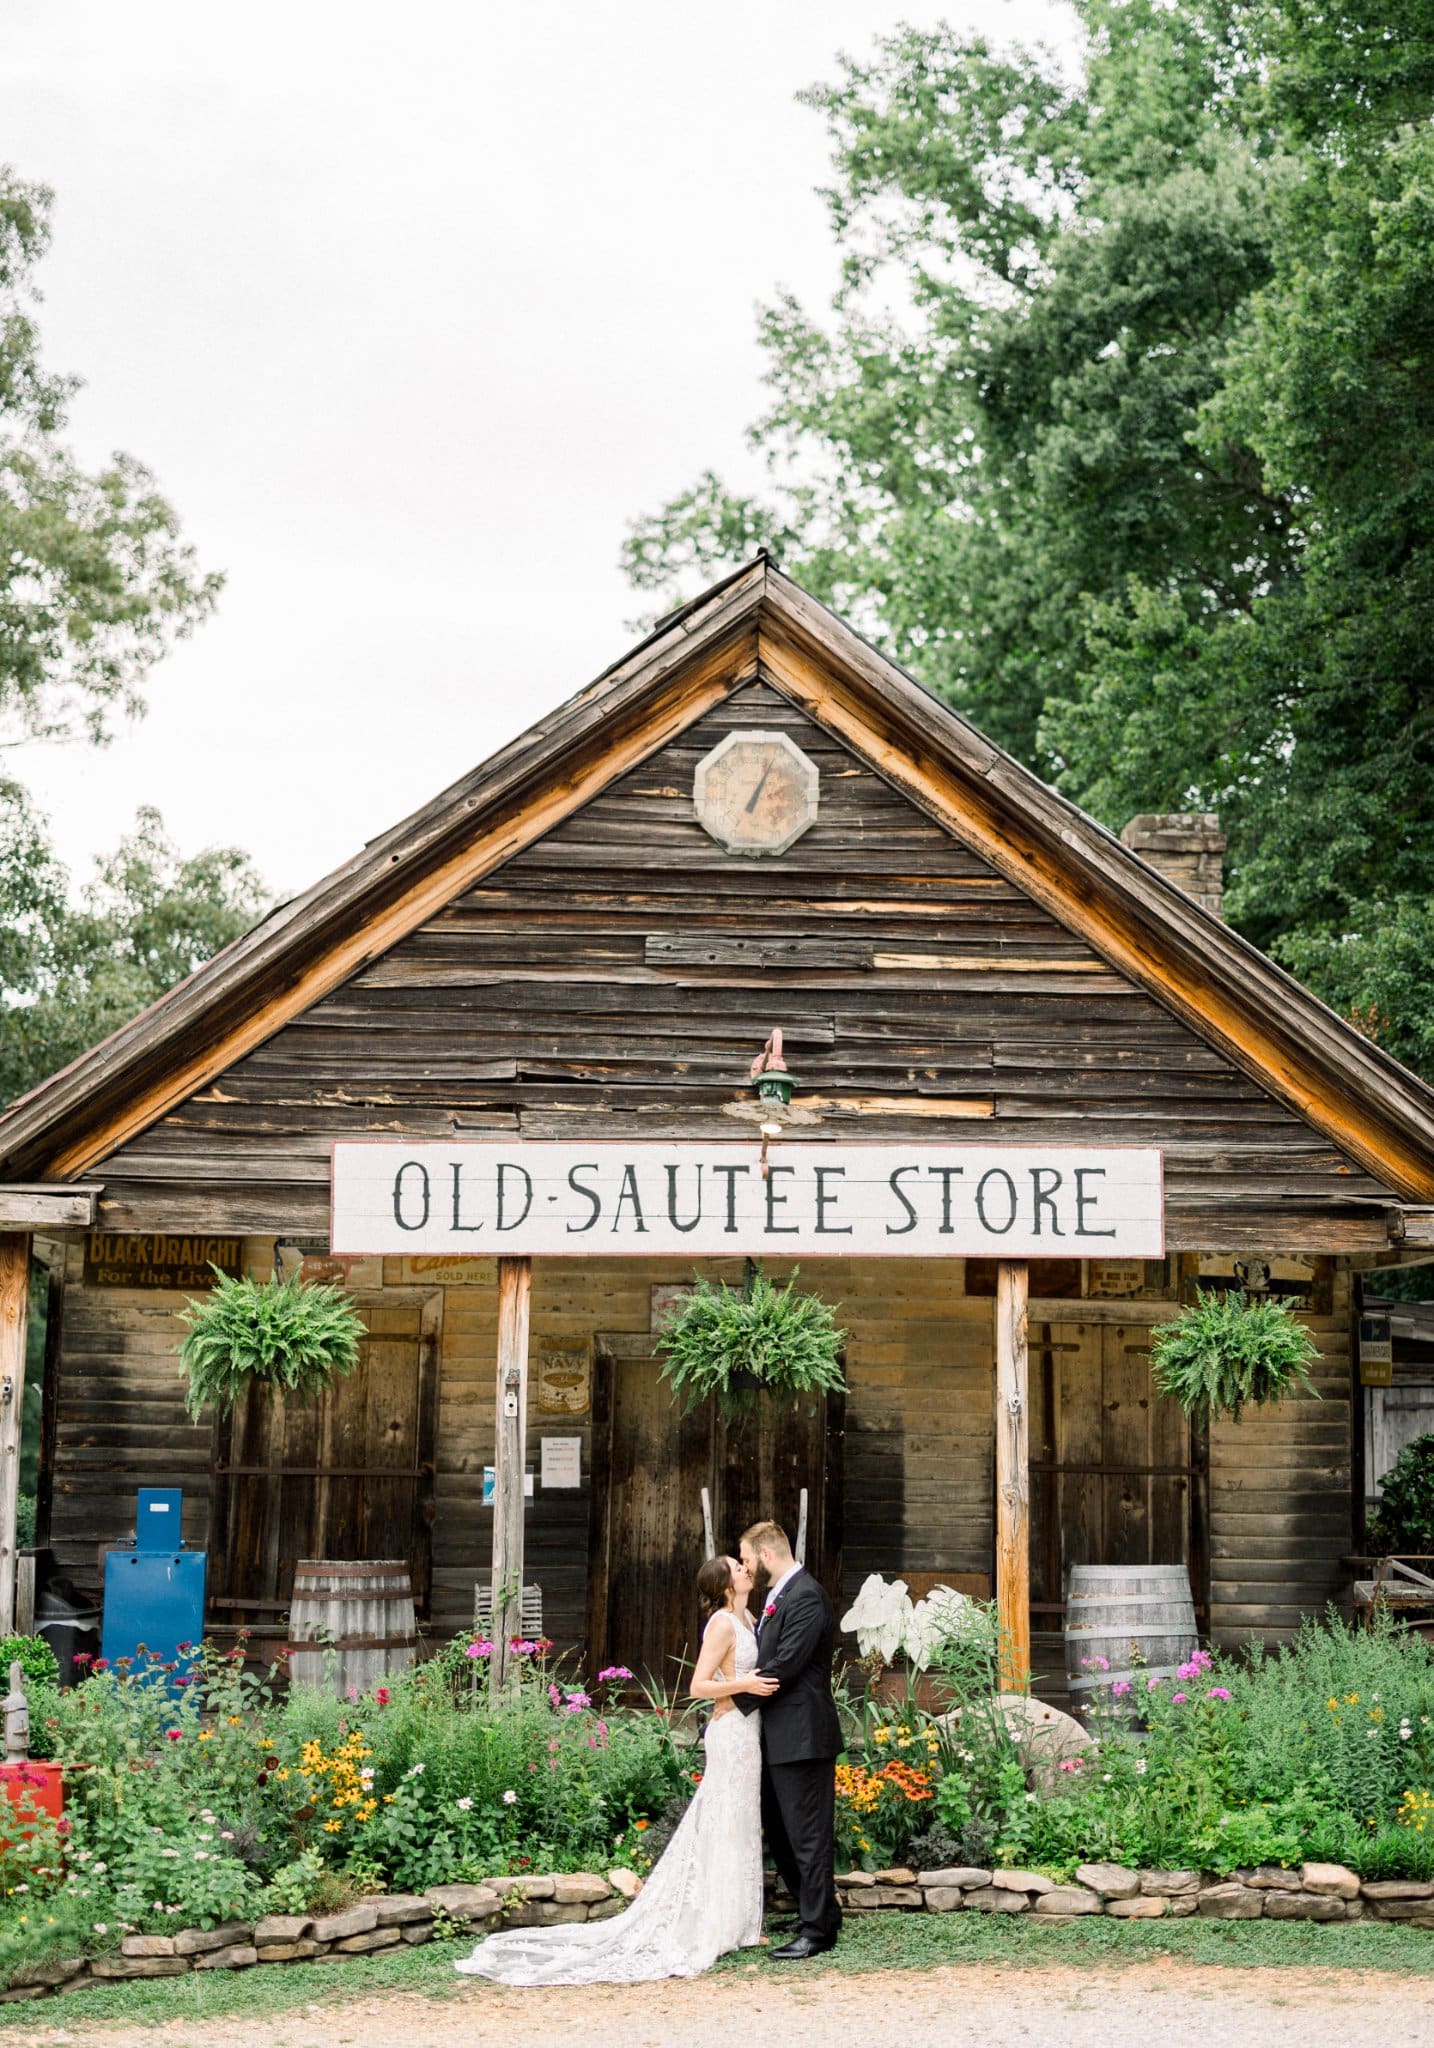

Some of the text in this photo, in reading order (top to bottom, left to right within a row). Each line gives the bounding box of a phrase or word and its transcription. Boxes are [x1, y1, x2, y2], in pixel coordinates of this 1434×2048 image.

[886, 1165, 1116, 1236] STORE
[97, 1269, 220, 1286] For the Live
[436, 1271, 493, 1281] SOLD HERE
[544, 1356, 585, 1370] NAVY
